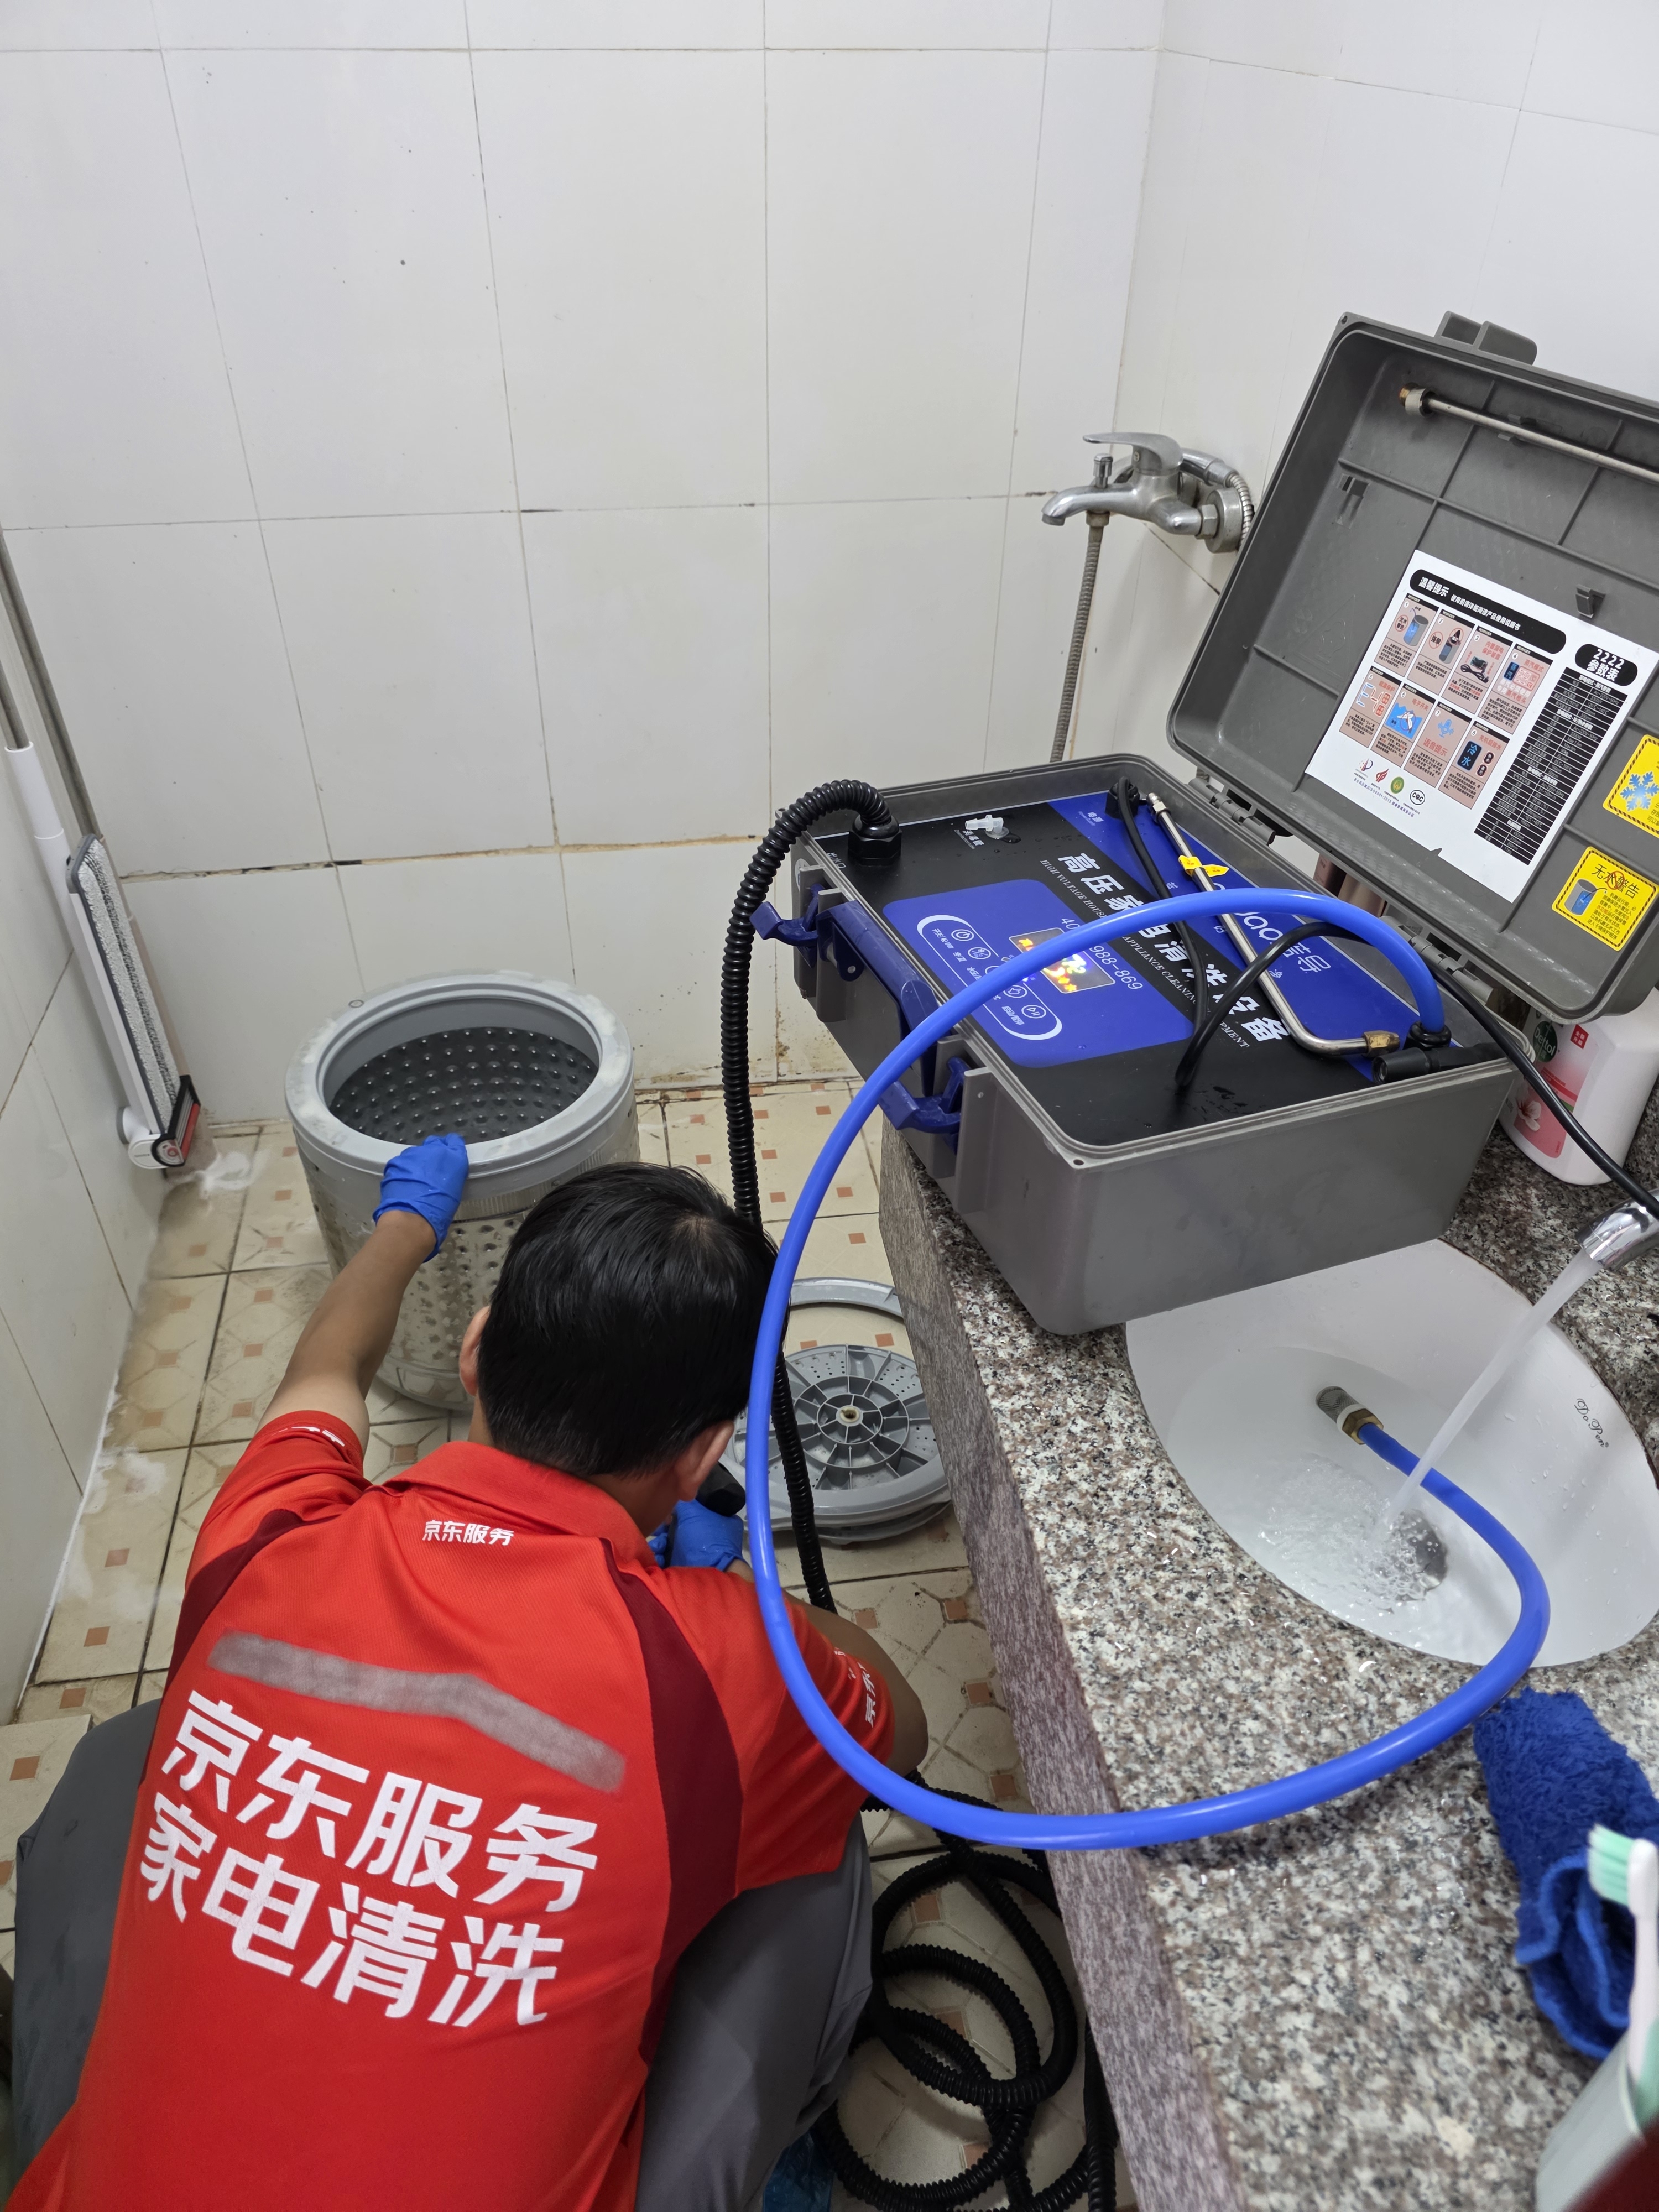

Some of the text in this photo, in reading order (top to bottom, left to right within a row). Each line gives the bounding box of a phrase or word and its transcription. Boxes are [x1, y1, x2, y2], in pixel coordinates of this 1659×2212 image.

[1418, 576, 1522, 631] 温馨提示 使用前请详细阅读产品使用说明书
[1481, 647, 1501, 660] 保护装置
[1592, 648, 1626, 670] 2222
[1505, 663, 1517, 679] 蒸汽
[1524, 659, 1545, 673] 蒸汽模式
[1585, 658, 1621, 682] 参数表
[1411, 698, 1430, 711] 电子开关
[1422, 737, 1448, 757] 语音提示
[1478, 734, 1503, 751] 关机后排水
[1460, 743, 1479, 768] 冷水
[1590, 862, 1642, 900] 无水警告
[1040, 859, 1057, 877] HIGH
[1057, 873, 1087, 901] VOLTAGE
[1123, 936, 1165, 971] APPLIANCE
[1534, 1027, 1556, 1056] Dettol
[422, 1520, 514, 1546] 京东服务
[163, 1689, 598, 1913] 京东服务
[140, 1791, 565, 2028] 家电清洗
